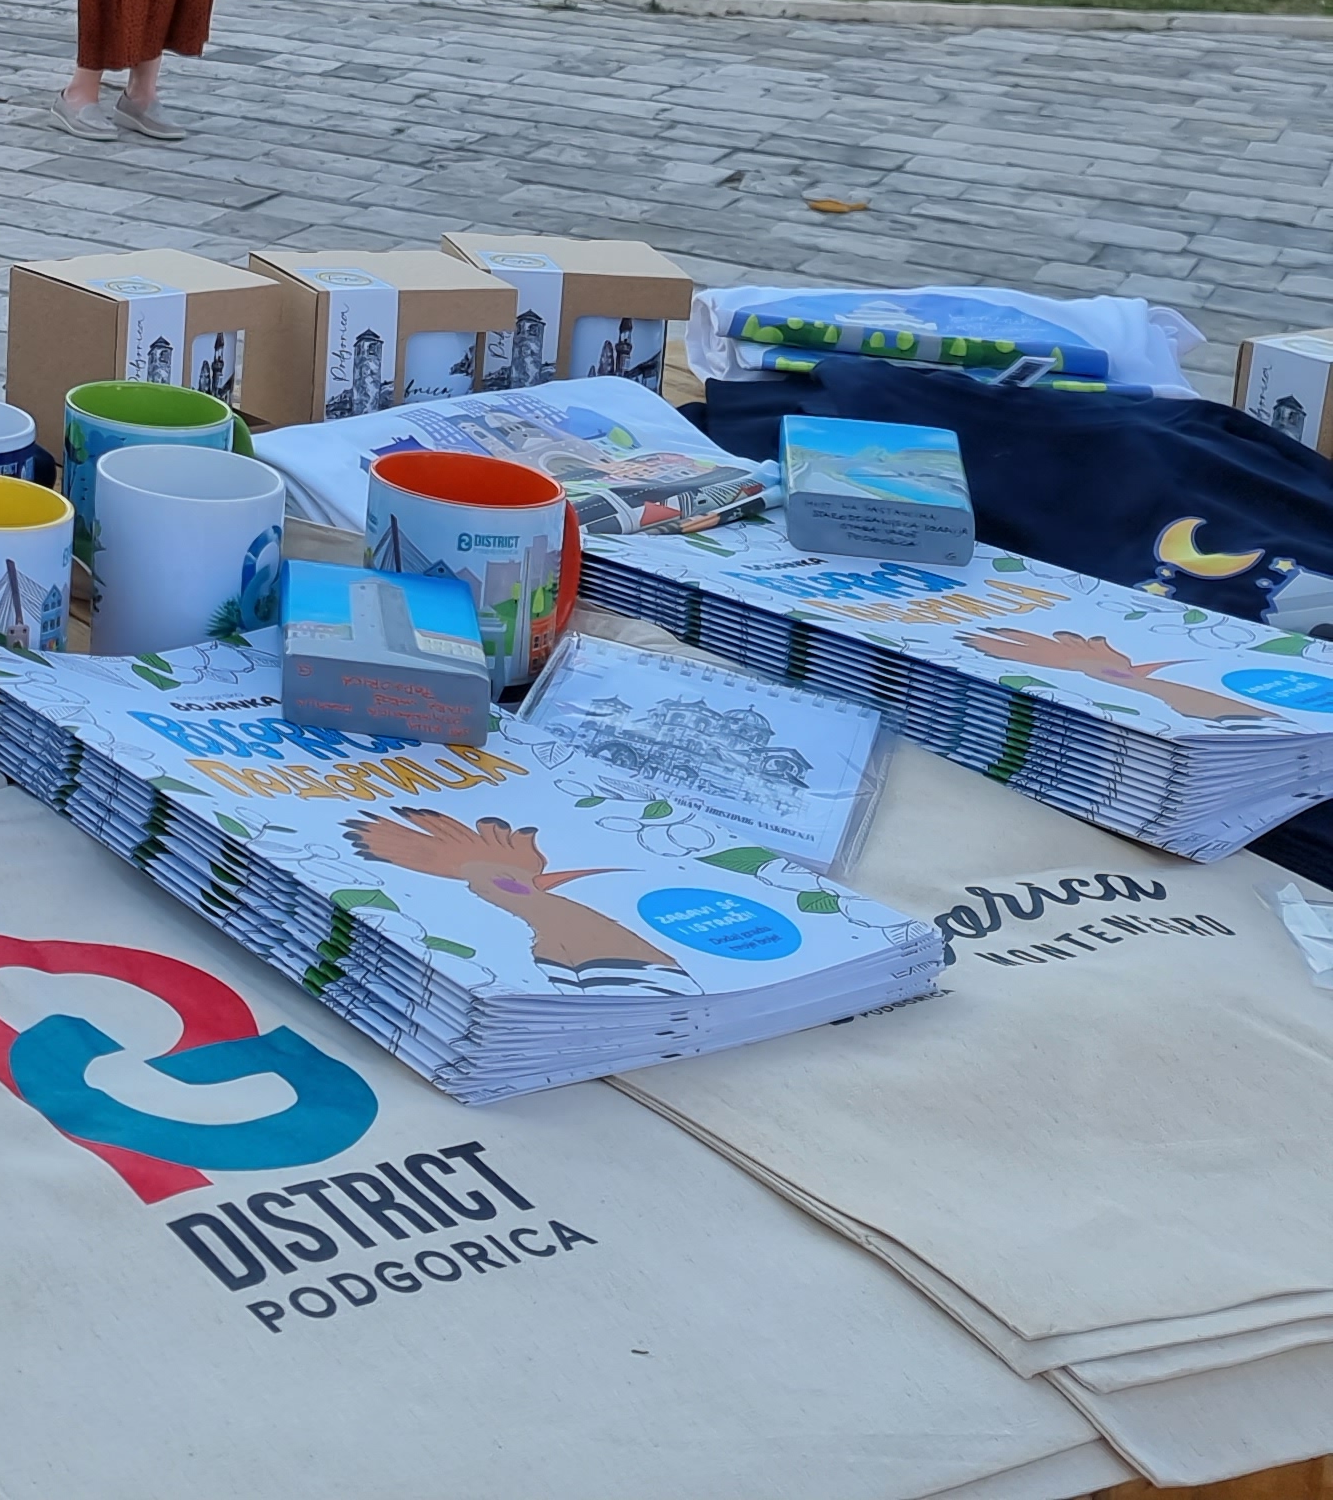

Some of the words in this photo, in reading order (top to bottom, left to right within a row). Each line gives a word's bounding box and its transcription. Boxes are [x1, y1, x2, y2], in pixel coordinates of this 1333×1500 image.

[474, 534, 521, 549] DISTRICT
[169, 695, 283, 712] BOJANKA
[974, 913, 1237, 968] MONTENEGRO
[167, 1140, 536, 1293] DISTRICT
[246, 1219, 599, 1334] PODGORICA
